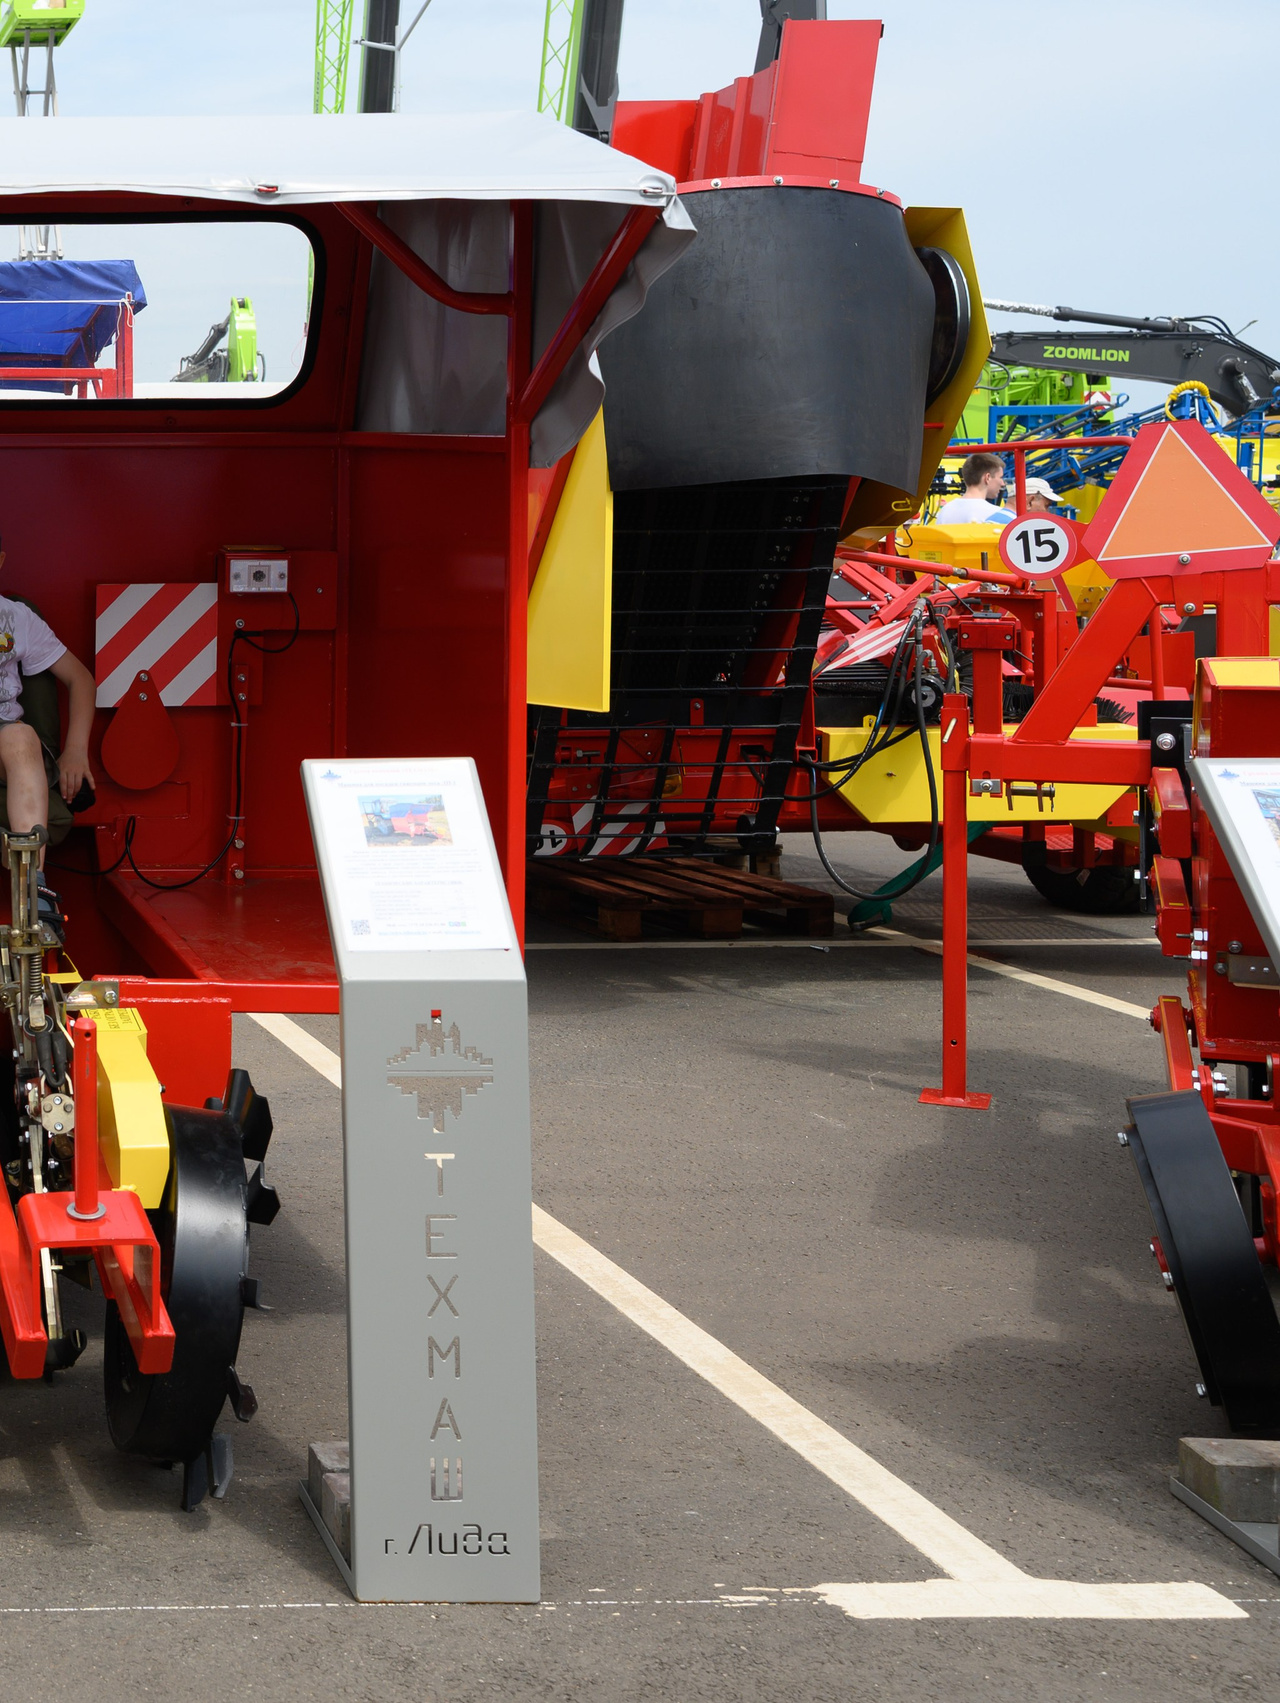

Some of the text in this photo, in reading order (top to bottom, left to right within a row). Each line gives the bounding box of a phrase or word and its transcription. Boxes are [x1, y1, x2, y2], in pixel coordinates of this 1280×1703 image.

[1043, 345, 1130, 362] ZOOMLION
[1015, 527, 1060, 563] 15
[424, 1153, 464, 1502] ТЕХМАШ
[384, 1523, 511, 1555] г. Лида
